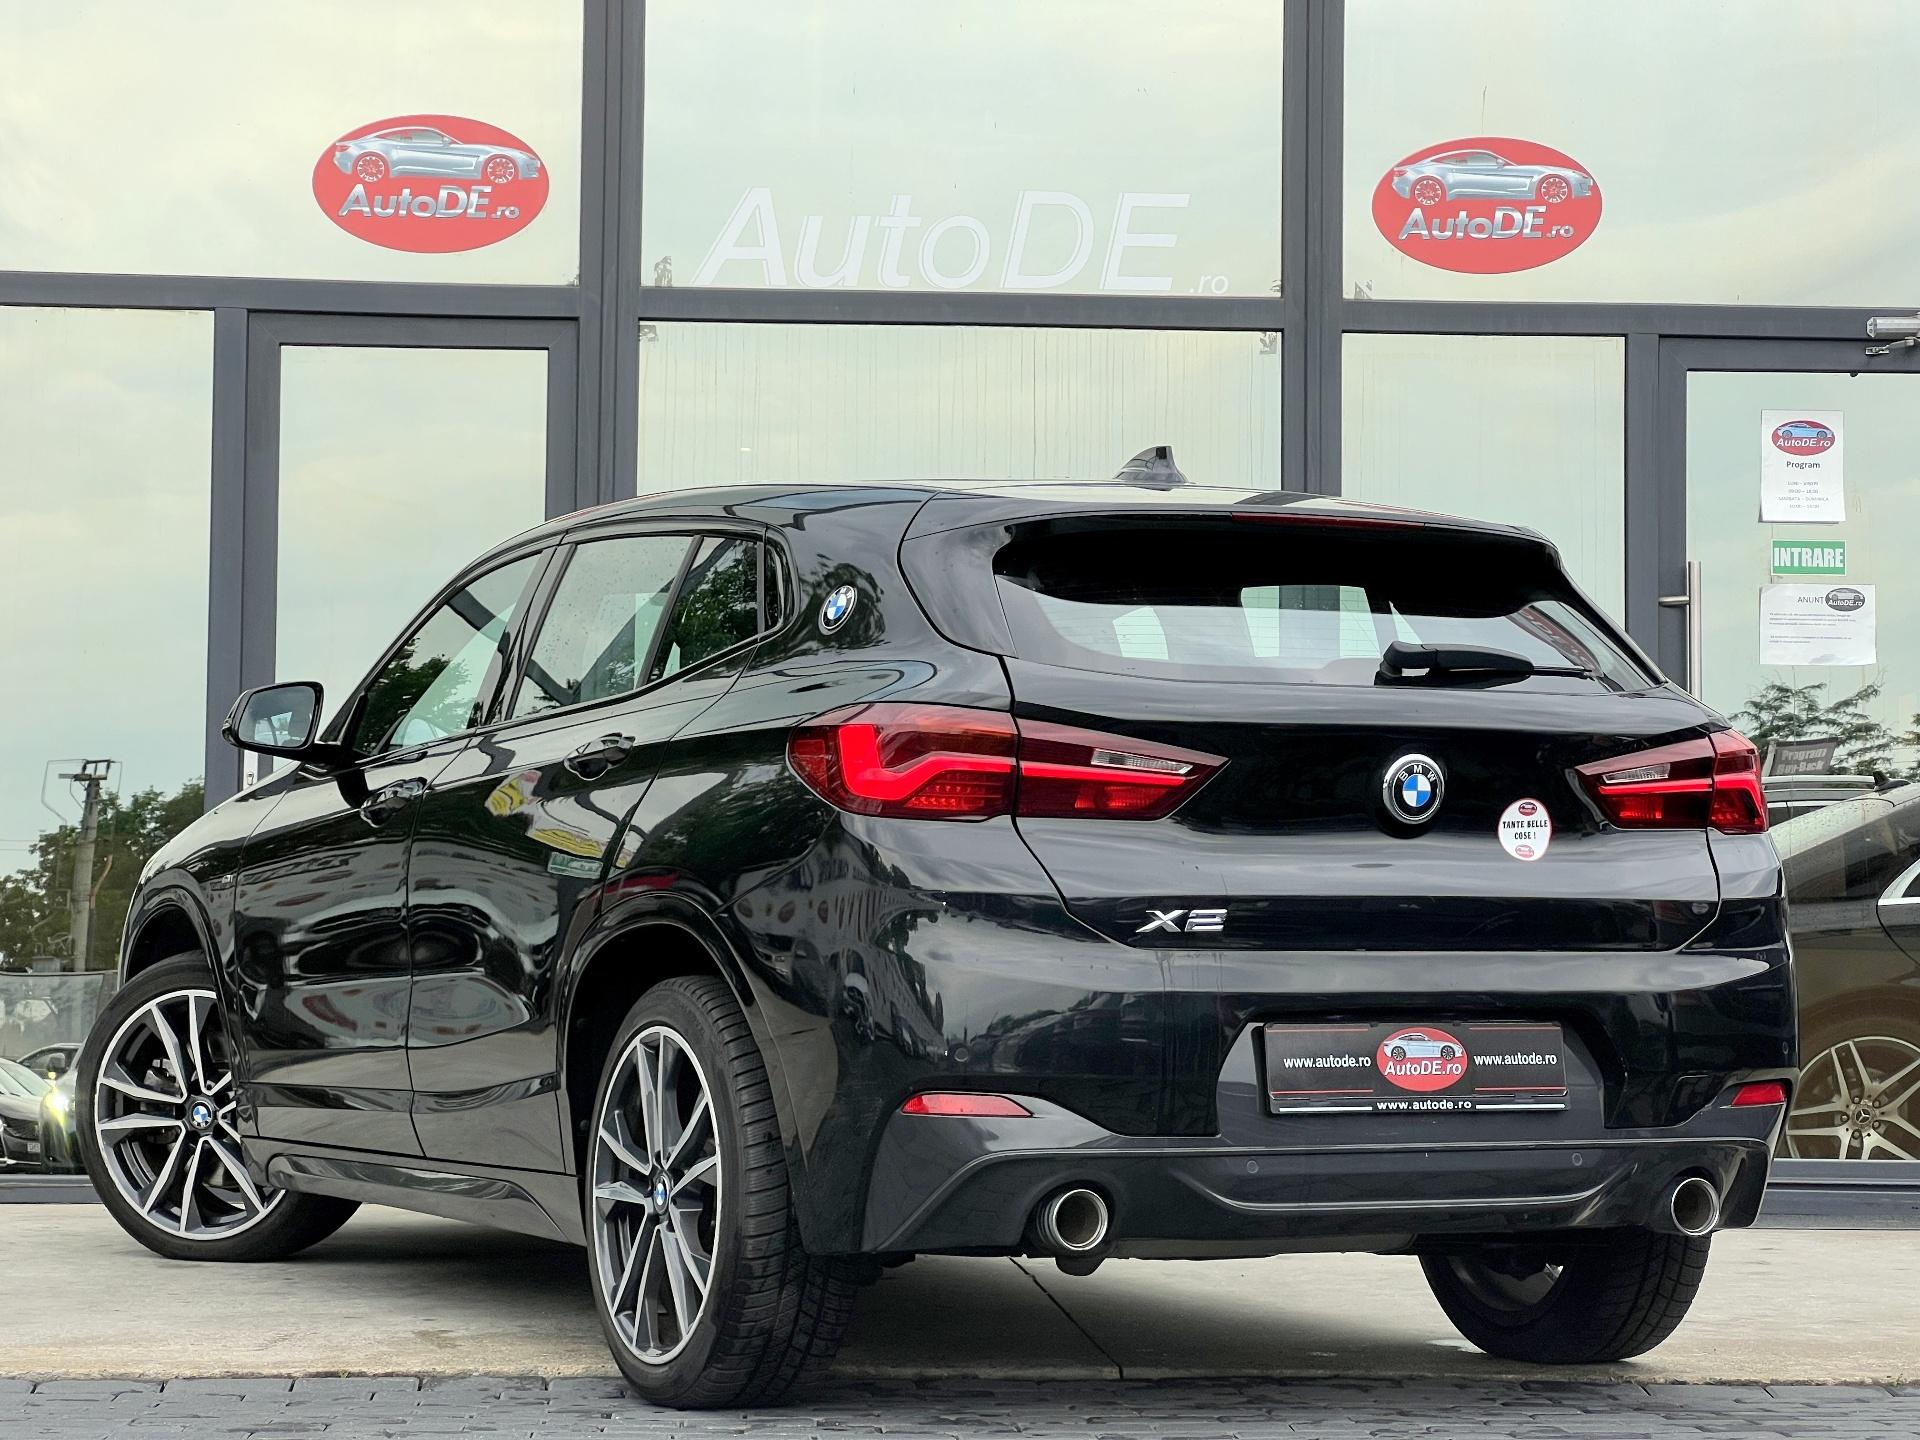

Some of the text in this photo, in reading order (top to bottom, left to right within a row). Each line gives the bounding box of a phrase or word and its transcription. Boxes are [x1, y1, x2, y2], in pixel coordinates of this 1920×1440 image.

[1776, 438, 1831, 448] AutoDE.ro
[1786, 460, 1821, 469] Program
[1773, 547, 1844, 568] INTRARE
[1828, 599, 1863, 607] AutoDE.ro
[1399, 764, 1437, 783] BMW
[1503, 819, 1548, 829] TANTE BELLE
[1514, 831, 1531, 840] COSE
[1135, 908, 1227, 933] X2
[1284, 1054, 1371, 1069] www.autode.ro
[1473, 1052, 1557, 1066] www.autode.ro
[1384, 1060, 1462, 1076] AutoDE.ro
[1376, 1100, 1472, 1111] www.autode.ro
